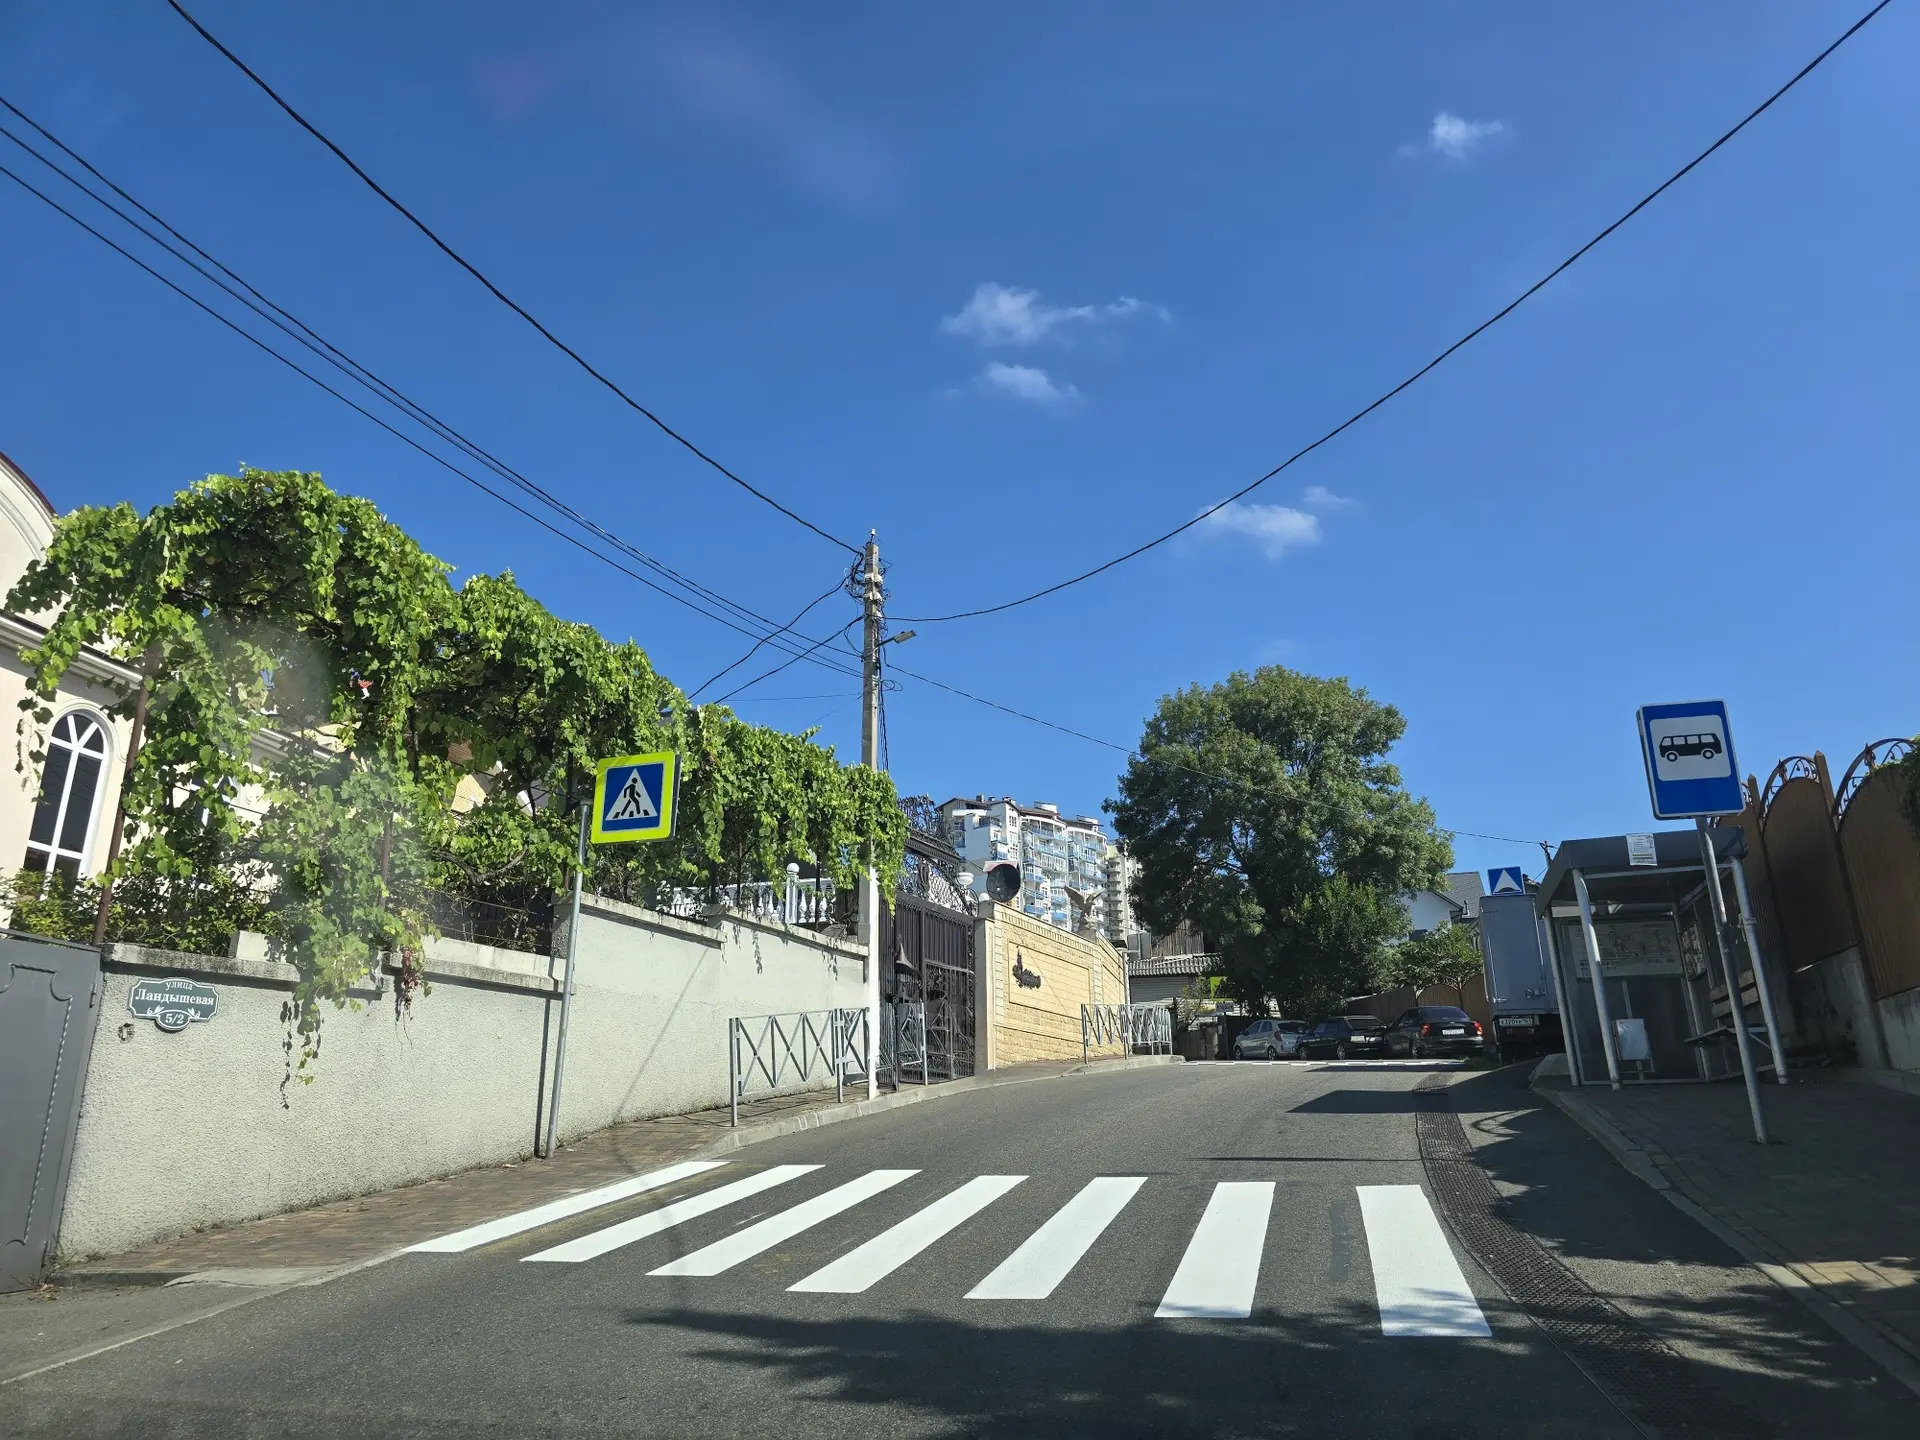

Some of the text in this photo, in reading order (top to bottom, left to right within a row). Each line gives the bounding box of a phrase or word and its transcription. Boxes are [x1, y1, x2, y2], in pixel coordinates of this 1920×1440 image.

[166, 981, 193, 991] улица
[135, 988, 215, 1006] Ландышевая
[165, 1013, 184, 1024] 5/2
